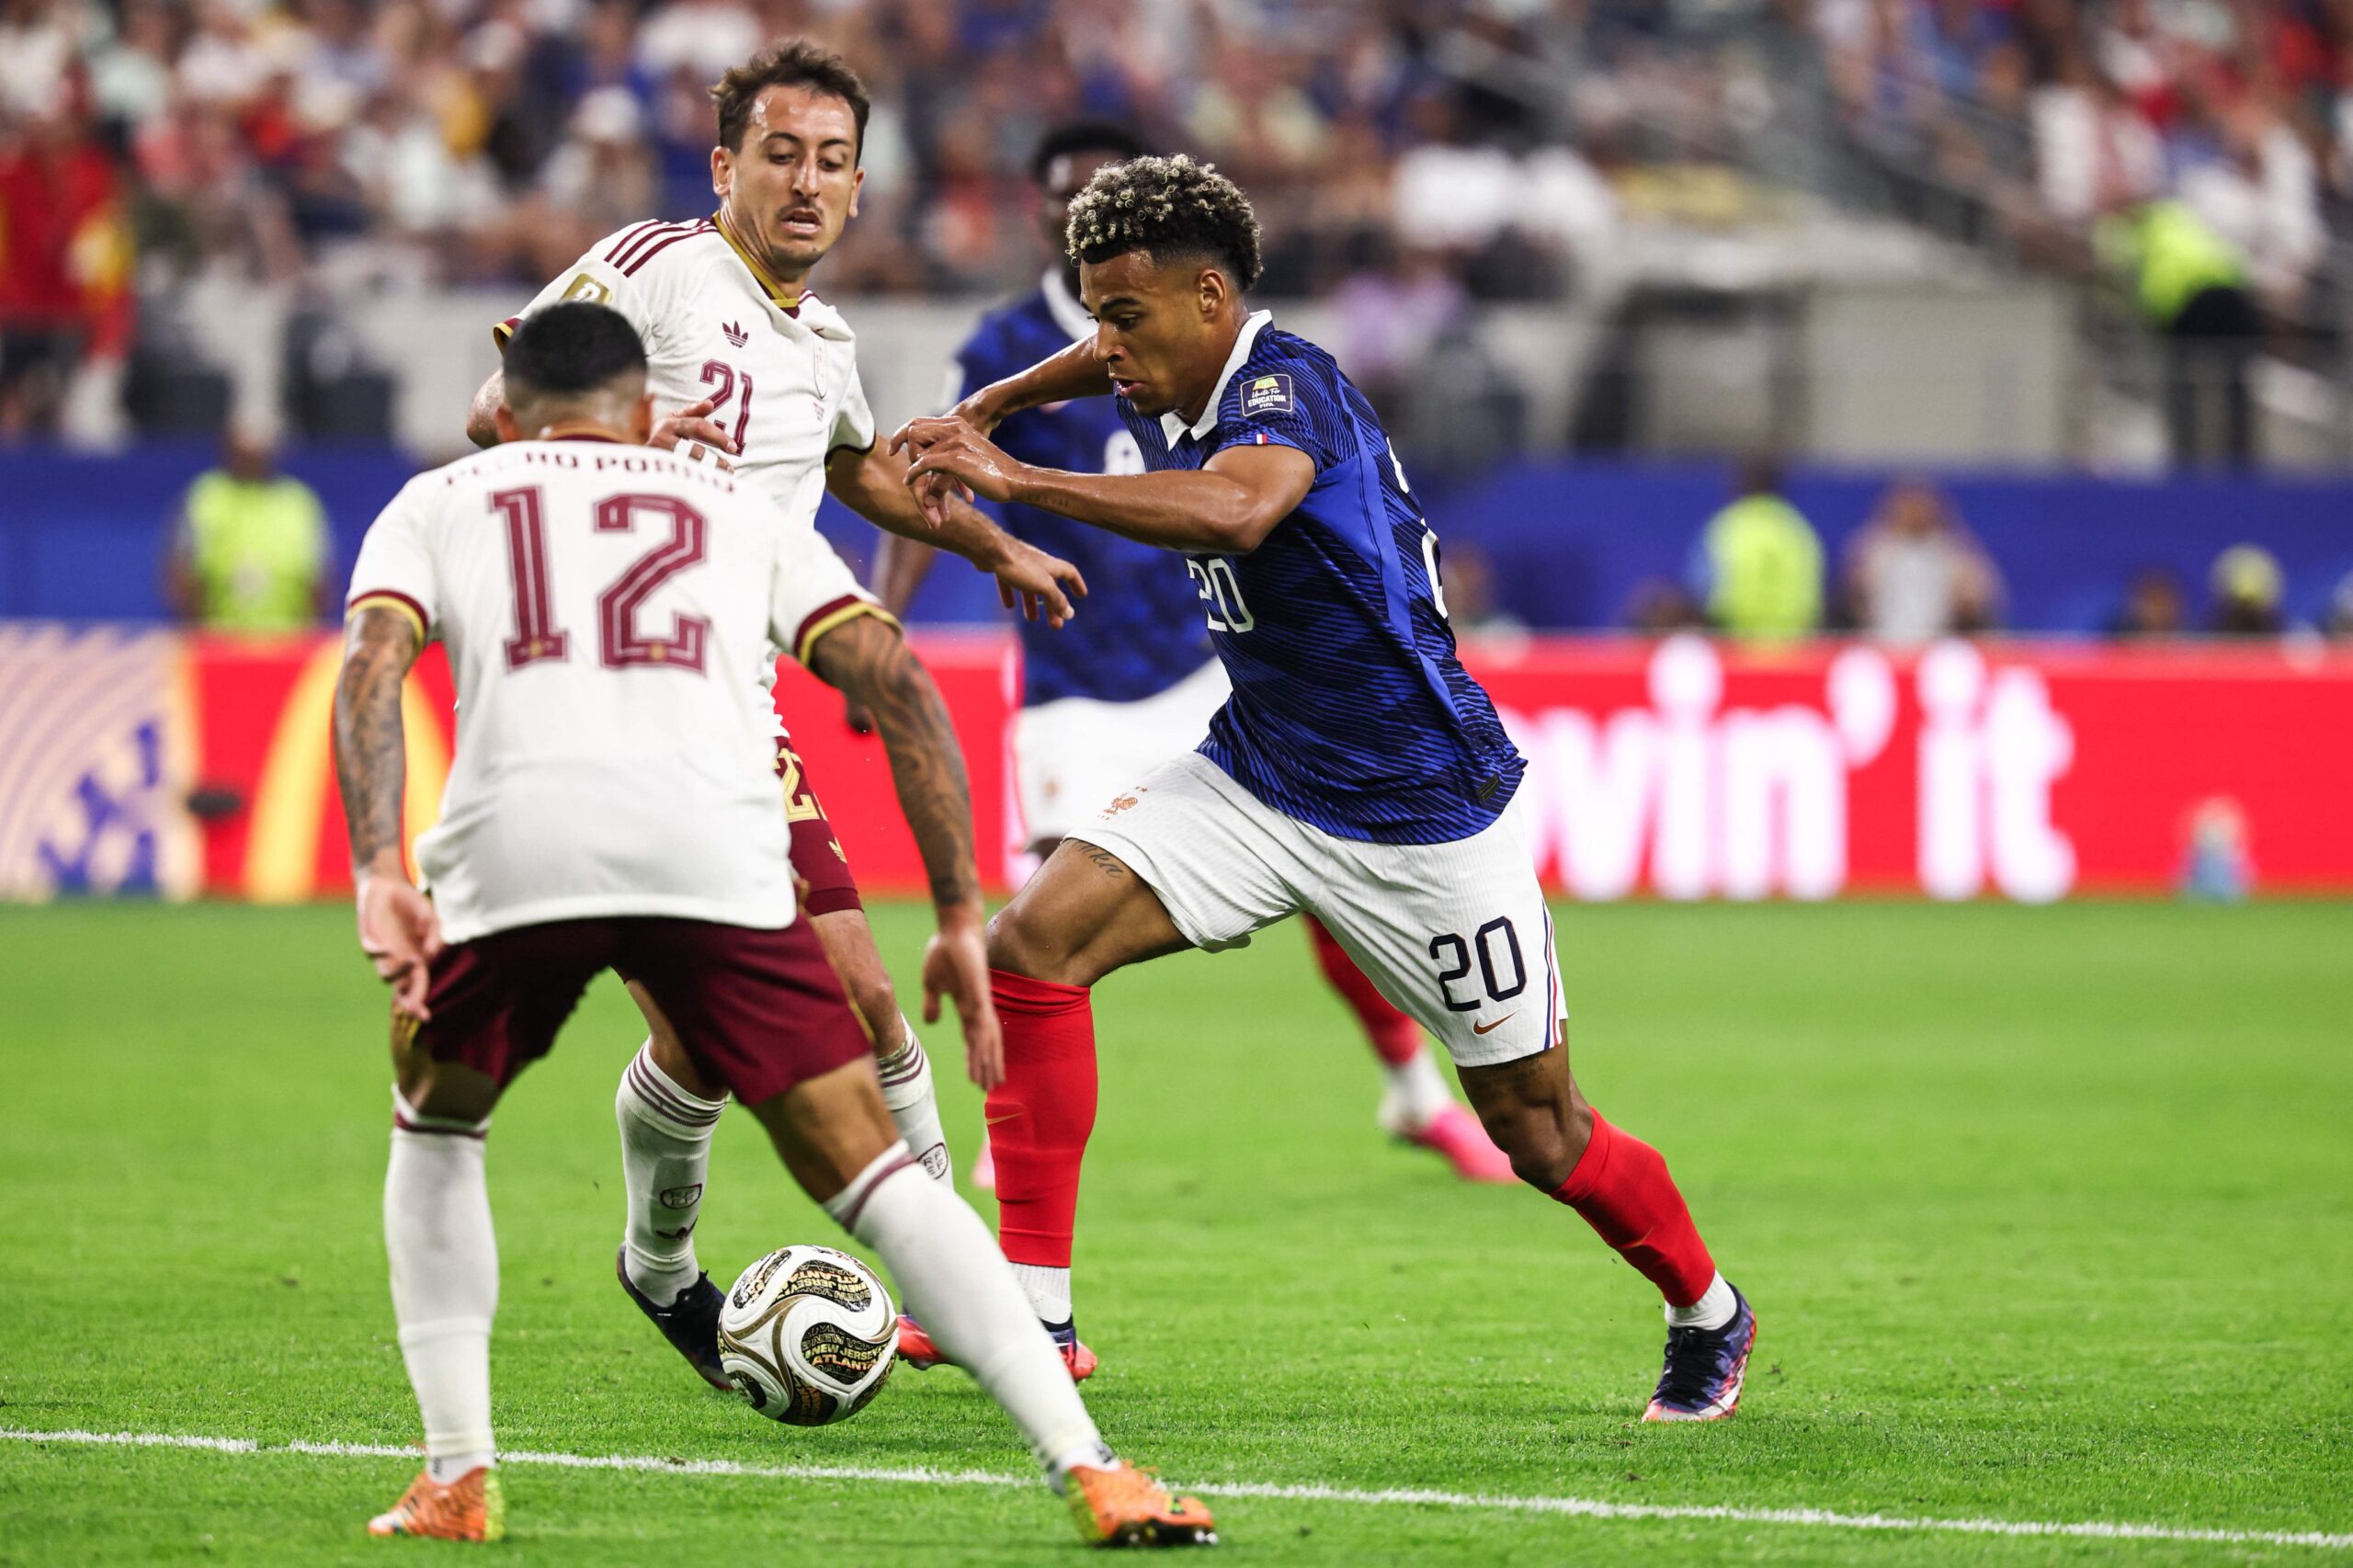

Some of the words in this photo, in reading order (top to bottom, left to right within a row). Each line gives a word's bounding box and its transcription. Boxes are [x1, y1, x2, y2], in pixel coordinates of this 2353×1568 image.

[687, 358, 753, 457] 21
[1247, 394, 1287, 407] EDUCATION
[487, 484, 711, 677] 12
[1186, 558, 1254, 634] 20
[772, 748, 828, 823] 2
[1916, 638, 2076, 903] it
[1428, 915, 1527, 1012] 20
[790, 1270, 858, 1285] ATLANTA
[791, 1278, 836, 1292] JERSEY
[837, 1282, 862, 1292] NEW
[811, 1344, 839, 1356] NEW
[840, 1346, 879, 1360] JERSEY
[811, 1354, 877, 1370] ATLANTA
